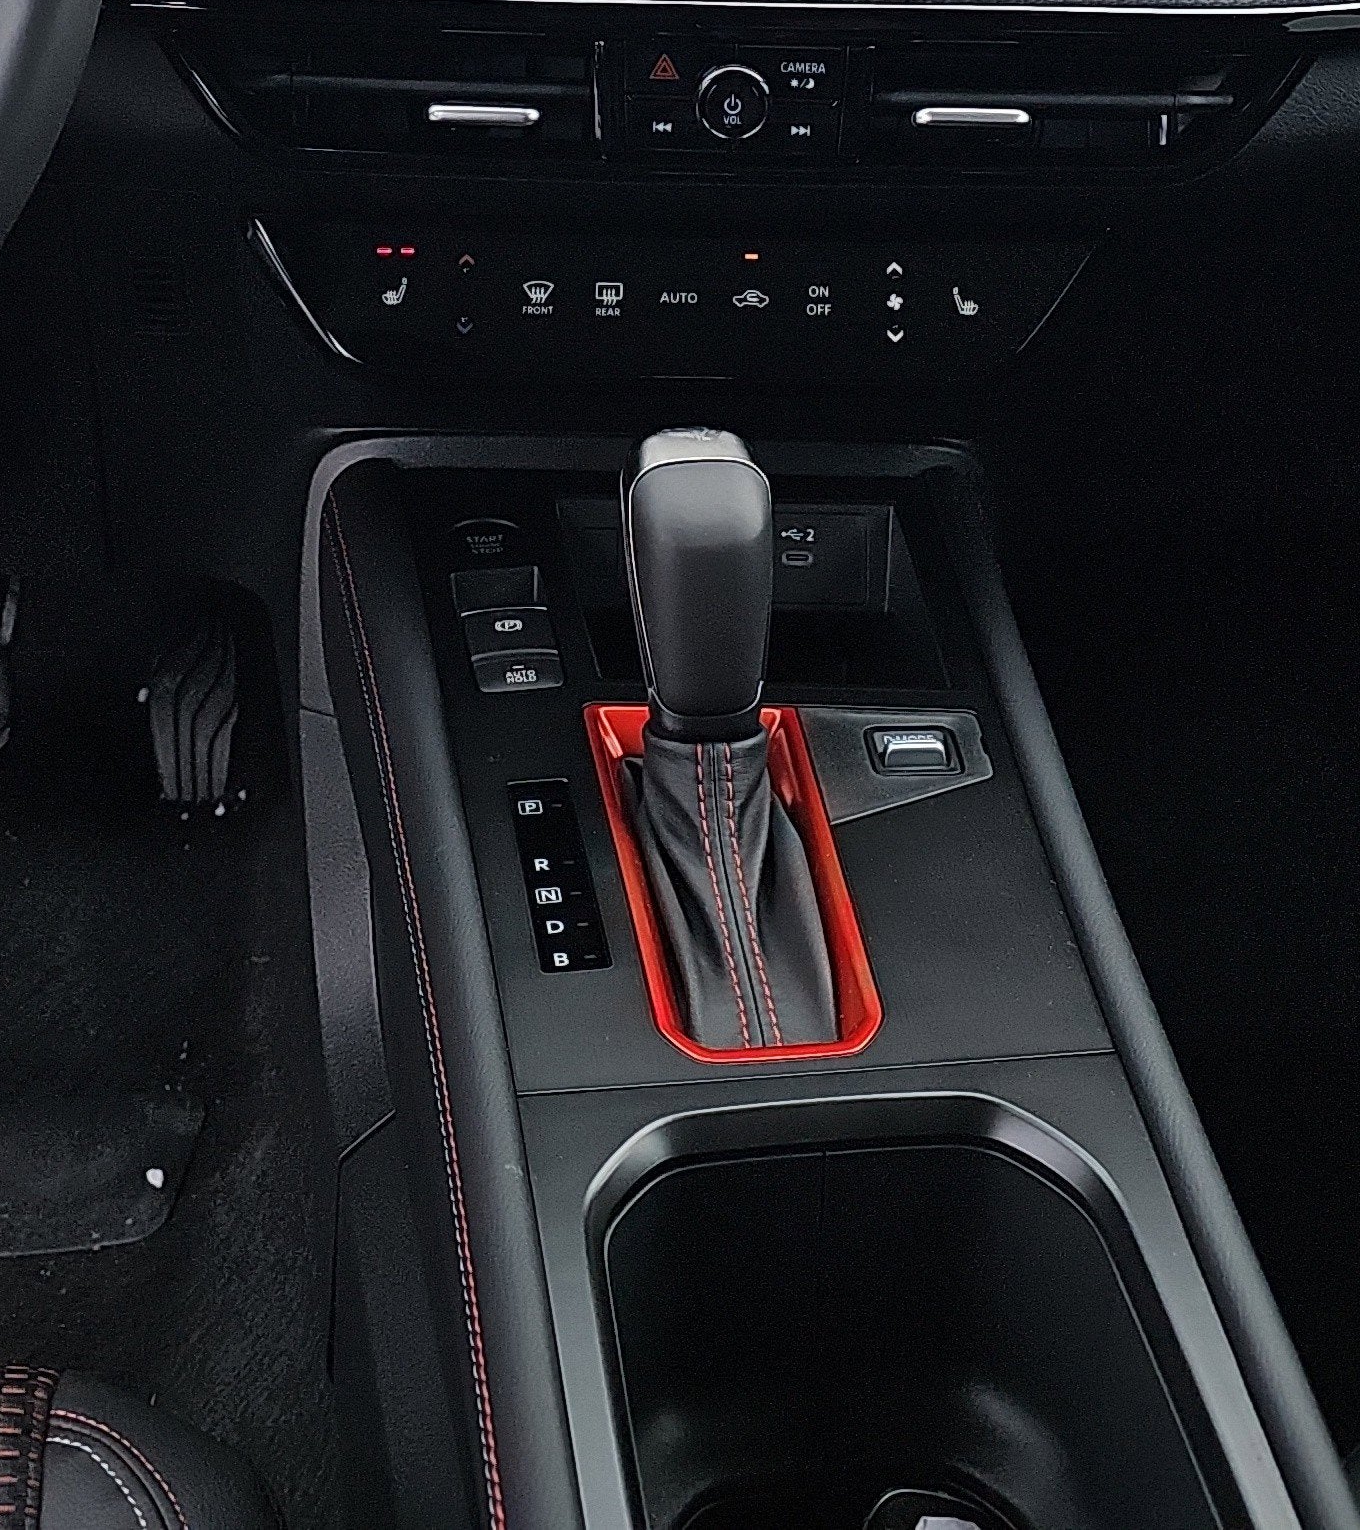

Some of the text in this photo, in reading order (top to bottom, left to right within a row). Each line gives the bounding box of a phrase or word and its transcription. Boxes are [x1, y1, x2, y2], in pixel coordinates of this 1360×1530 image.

[780, 61, 826, 74] CAMERA
[723, 115, 742, 125] VOL
[659, 292, 698, 304] AUTO
[808, 285, 829, 298] ON
[522, 305, 554, 315] FRONT
[595, 307, 621, 317] REAR
[806, 303, 832, 317] OFF
[805, 528, 815, 542] 2
[505, 670, 536, 678] AUTO
[533, 858, 550, 872] R
[540, 889, 557, 902] N
[545, 920, 565, 935] D
[552, 952, 570, 967] B
